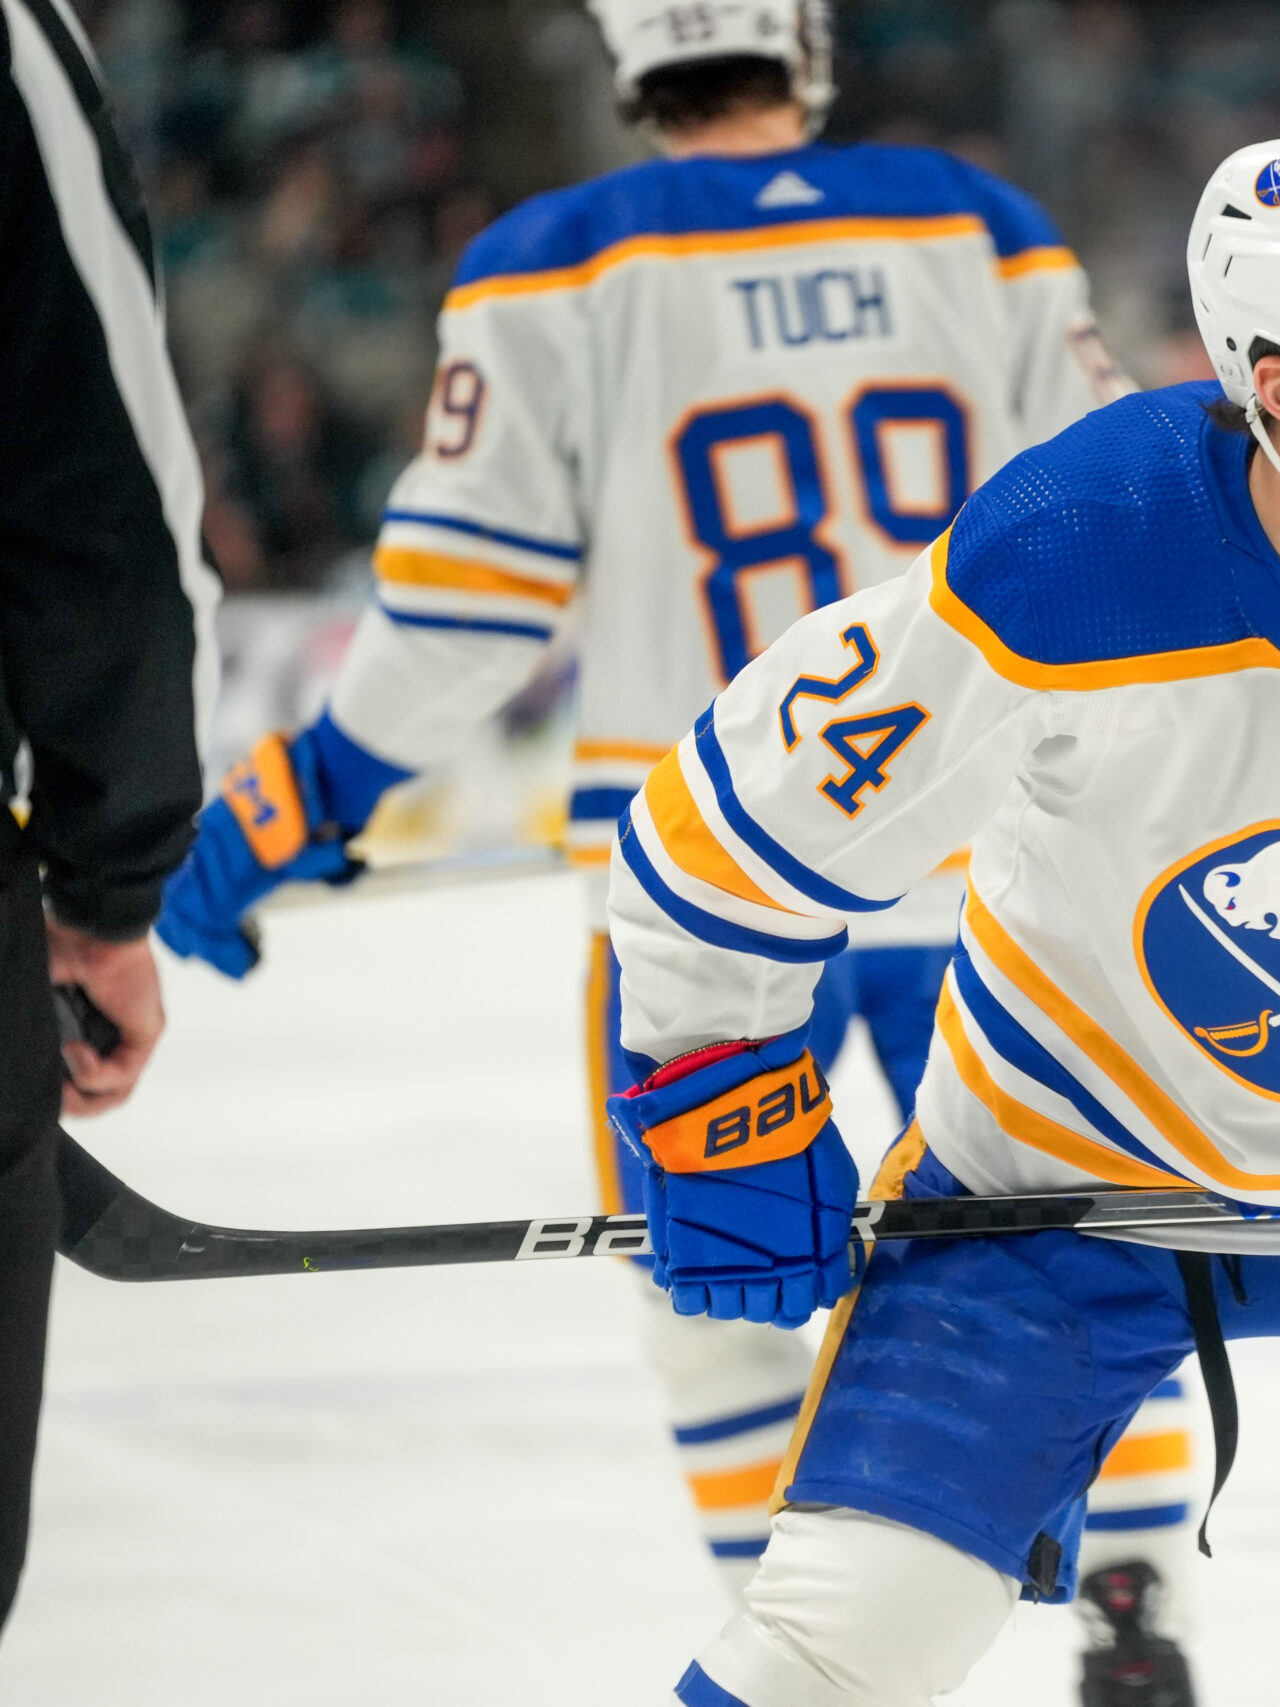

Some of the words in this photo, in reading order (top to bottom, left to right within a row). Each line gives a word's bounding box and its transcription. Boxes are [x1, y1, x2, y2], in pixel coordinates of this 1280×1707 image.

[729, 266, 893, 350] TUCH
[435, 357, 489, 462] 9
[778, 622, 932, 820] 24
[704, 1060, 830, 1158] BAU
